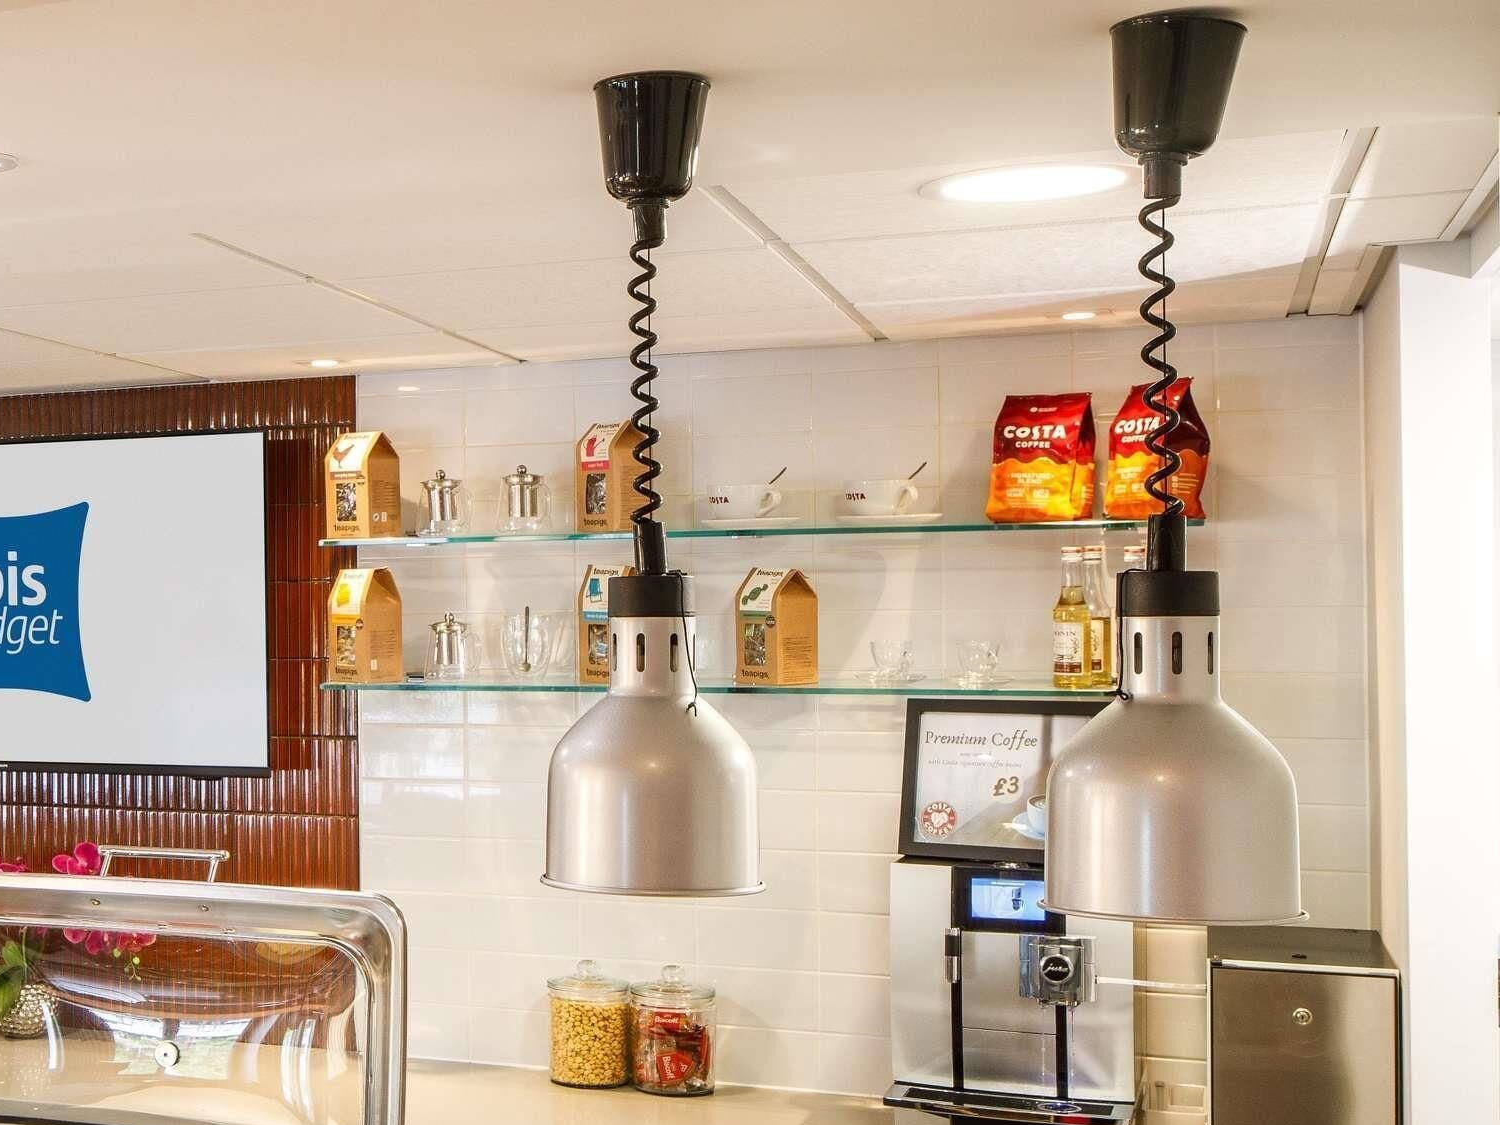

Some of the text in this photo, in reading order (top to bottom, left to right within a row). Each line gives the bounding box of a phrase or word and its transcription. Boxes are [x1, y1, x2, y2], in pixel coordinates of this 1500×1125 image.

[1003, 424, 1067, 440] COSTA
[1114, 416, 1161, 434] COSTA
[1015, 440, 1051, 449] COFFEE
[925, 729, 1038, 751] Premium Coffee
[993, 776, 1020, 796] £3
[927, 801, 952, 814] COSTA
[662, 1056, 676, 1080] Biscoff
